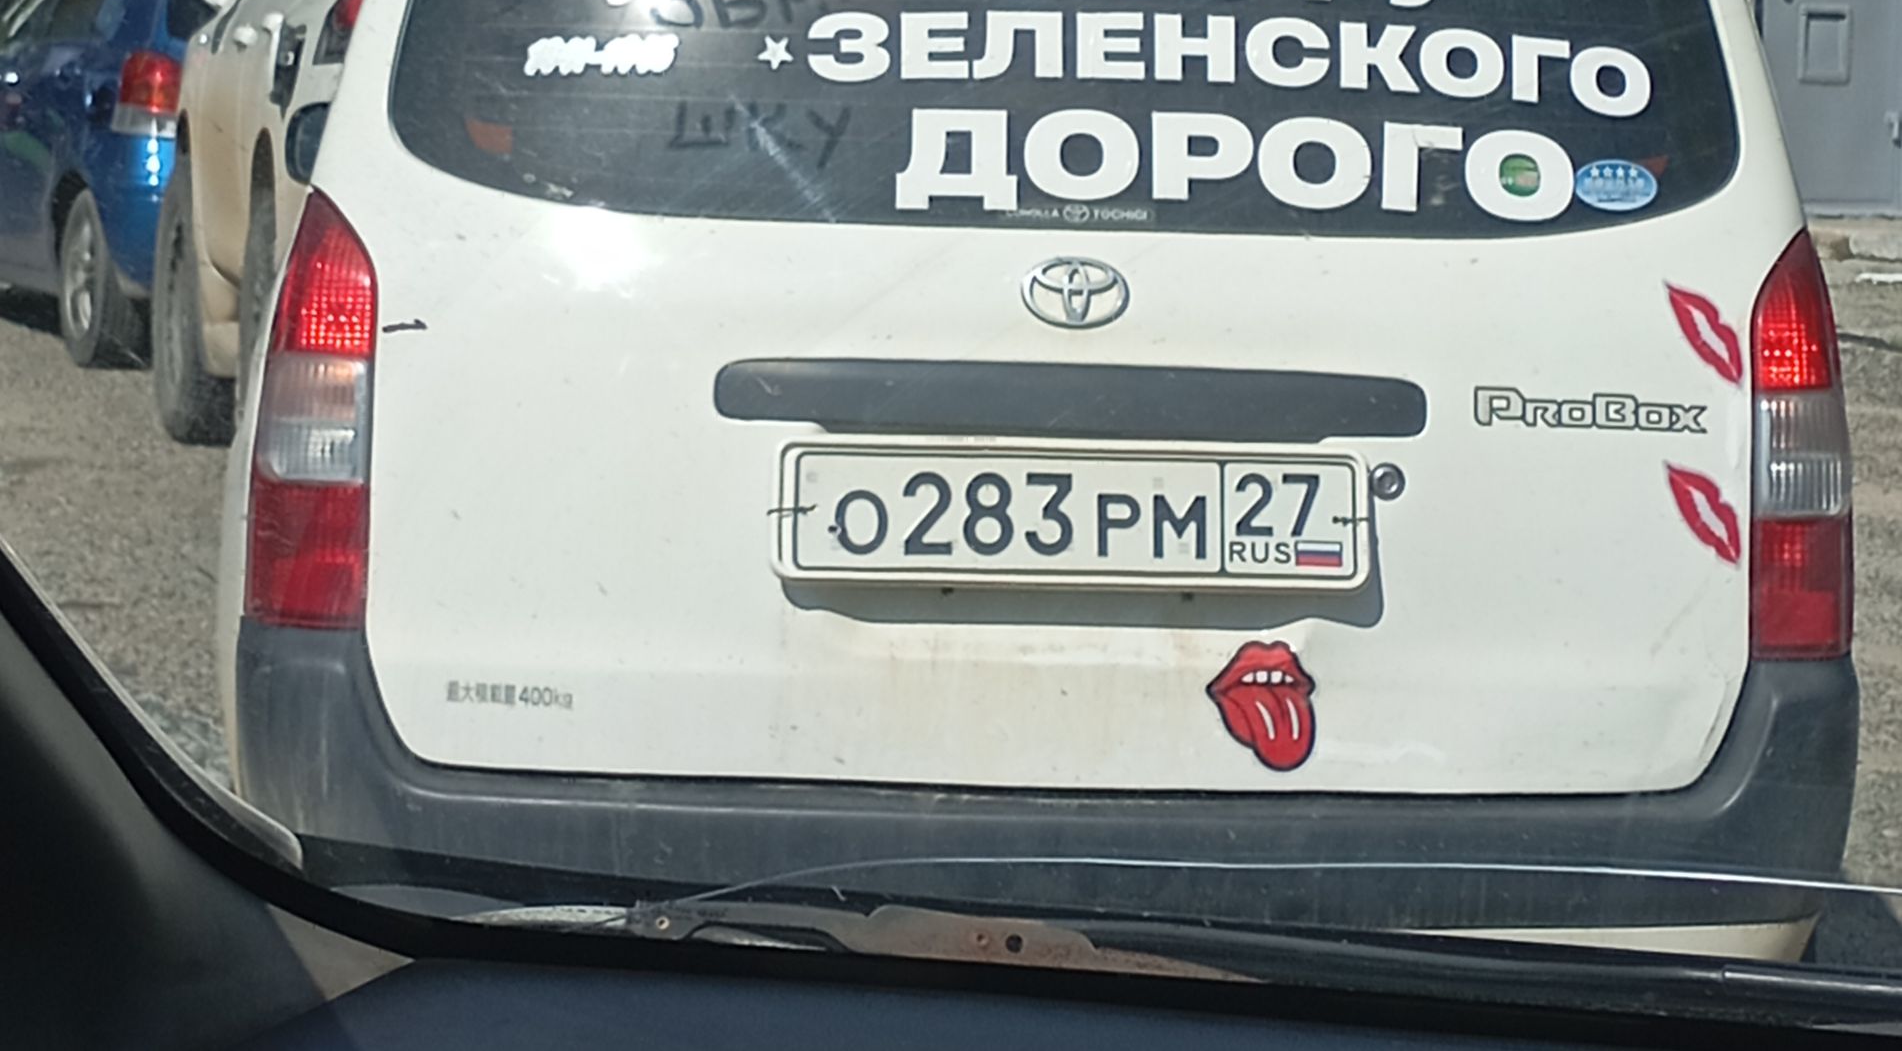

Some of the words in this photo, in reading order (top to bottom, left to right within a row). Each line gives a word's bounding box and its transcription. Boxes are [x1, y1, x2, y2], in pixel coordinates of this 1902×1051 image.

[806, 10, 1652, 118] ЗЕЛЕНСКОГО
[895, 108, 1575, 222] ДОРОГО
[1234, 471, 1320, 538] 27
[1228, 541, 1292, 564] RUS
